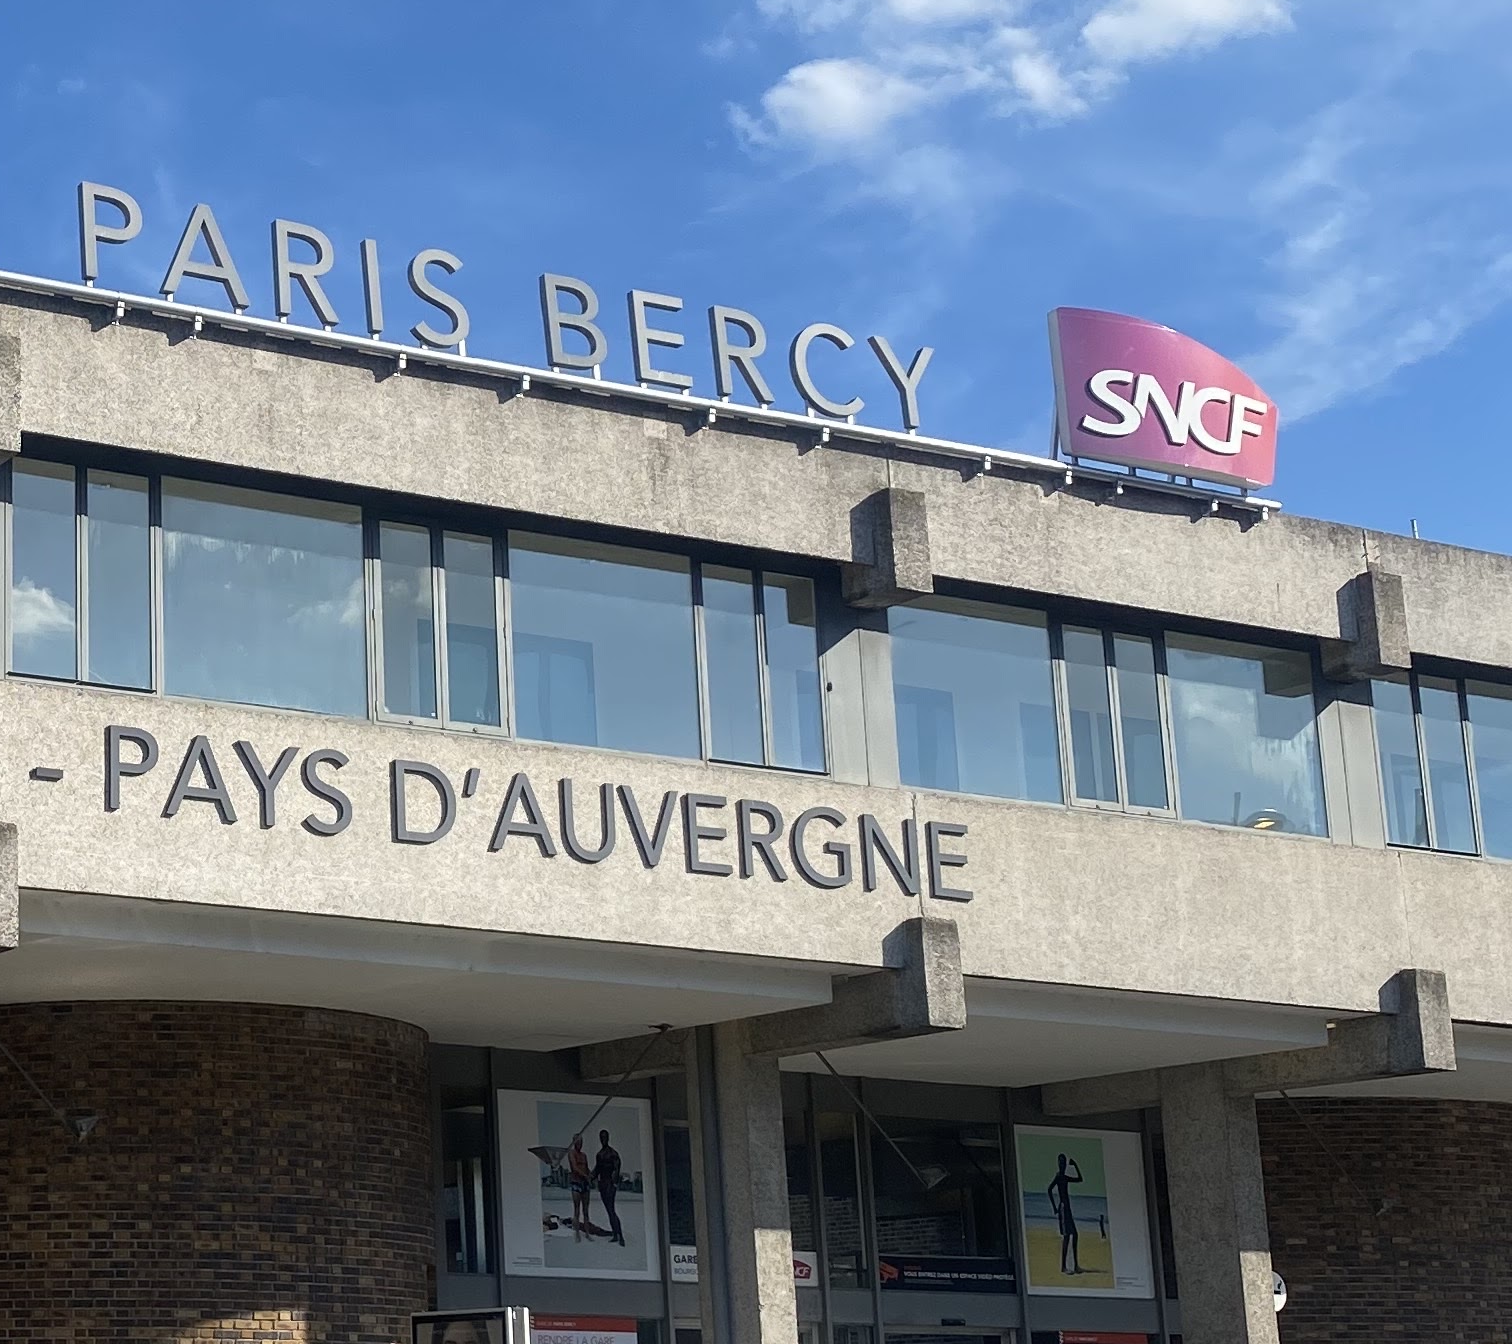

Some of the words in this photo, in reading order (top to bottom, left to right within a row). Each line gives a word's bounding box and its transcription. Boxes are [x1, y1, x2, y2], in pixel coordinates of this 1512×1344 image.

[77, 181, 470, 348] PARIS
[540, 272, 934, 429] BERCY
[1078, 369, 1268, 455] SNCF
[104, 725, 352, 837] PAYS
[390, 759, 974, 902] D'AUVERGNE
